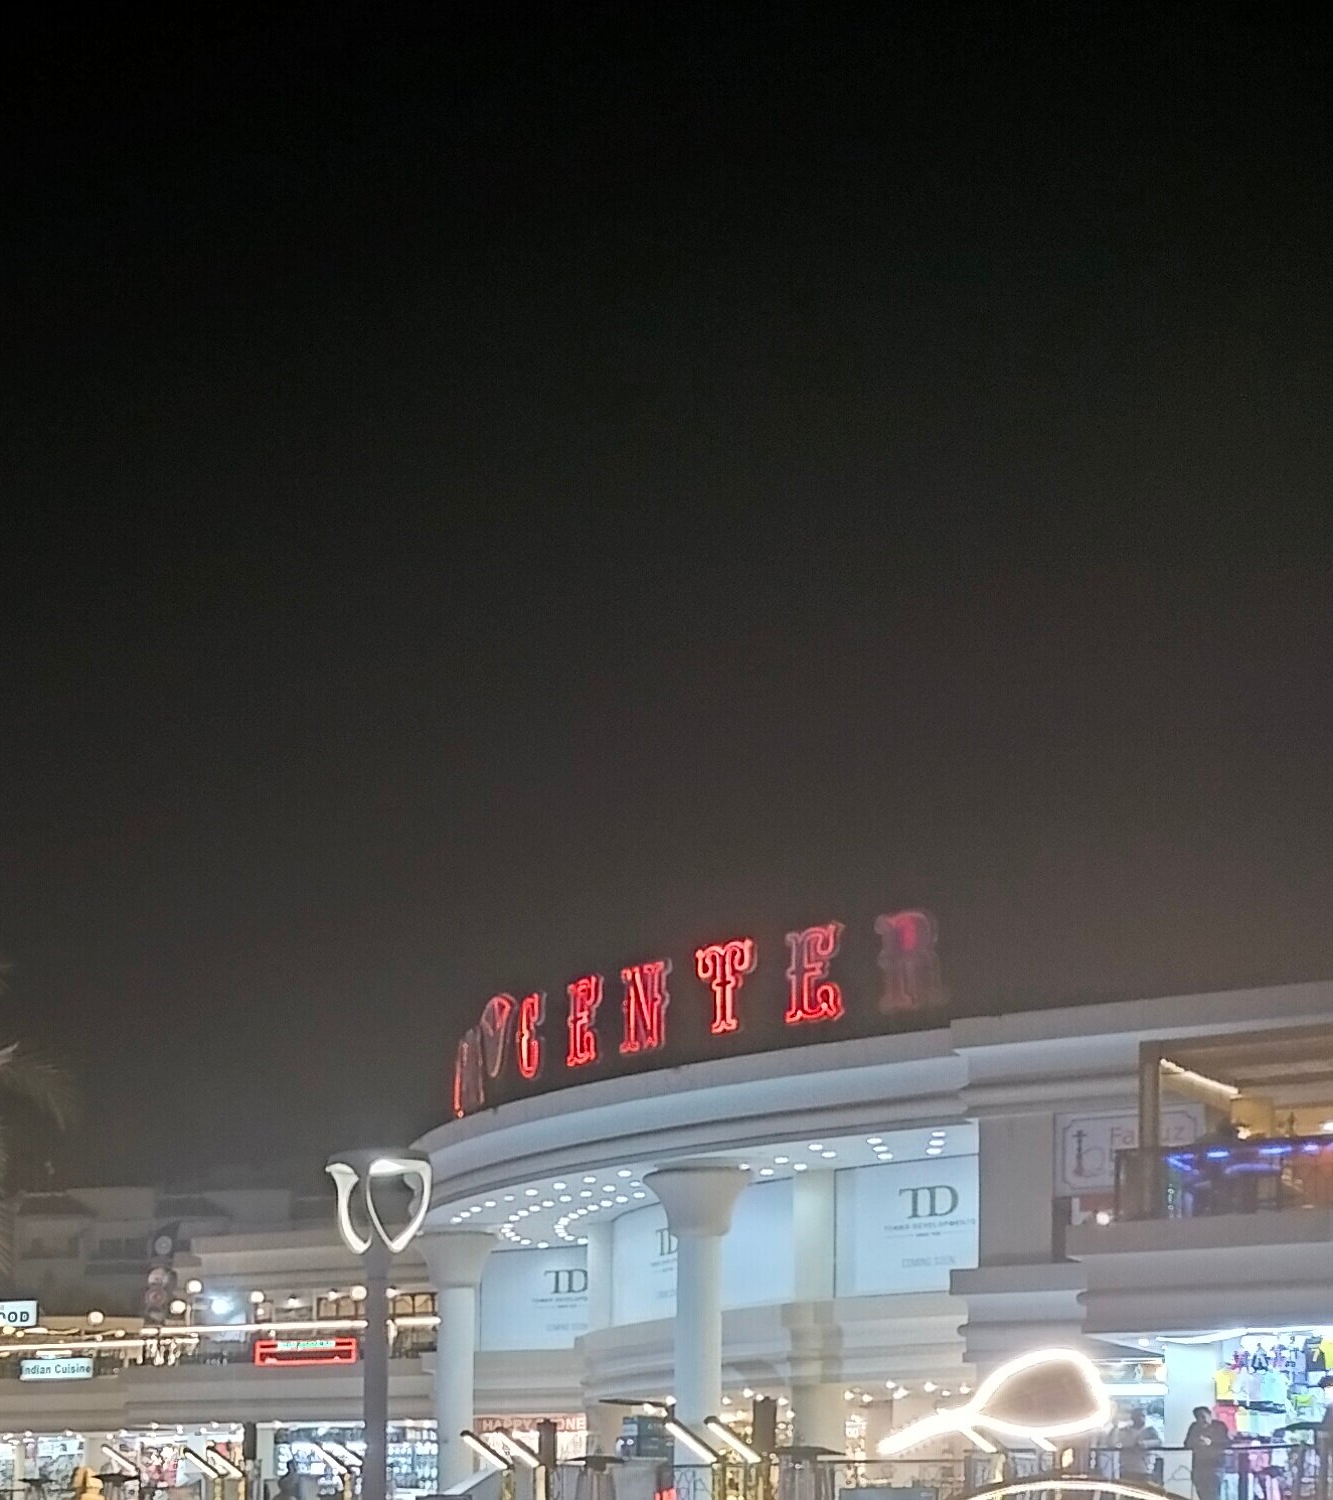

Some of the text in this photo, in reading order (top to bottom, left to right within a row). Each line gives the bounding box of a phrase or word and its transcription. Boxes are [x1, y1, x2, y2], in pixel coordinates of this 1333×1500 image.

[22, 1360, 91, 1375] ndian Cuisine
[482, 1419, 533, 1431] HAPPY
